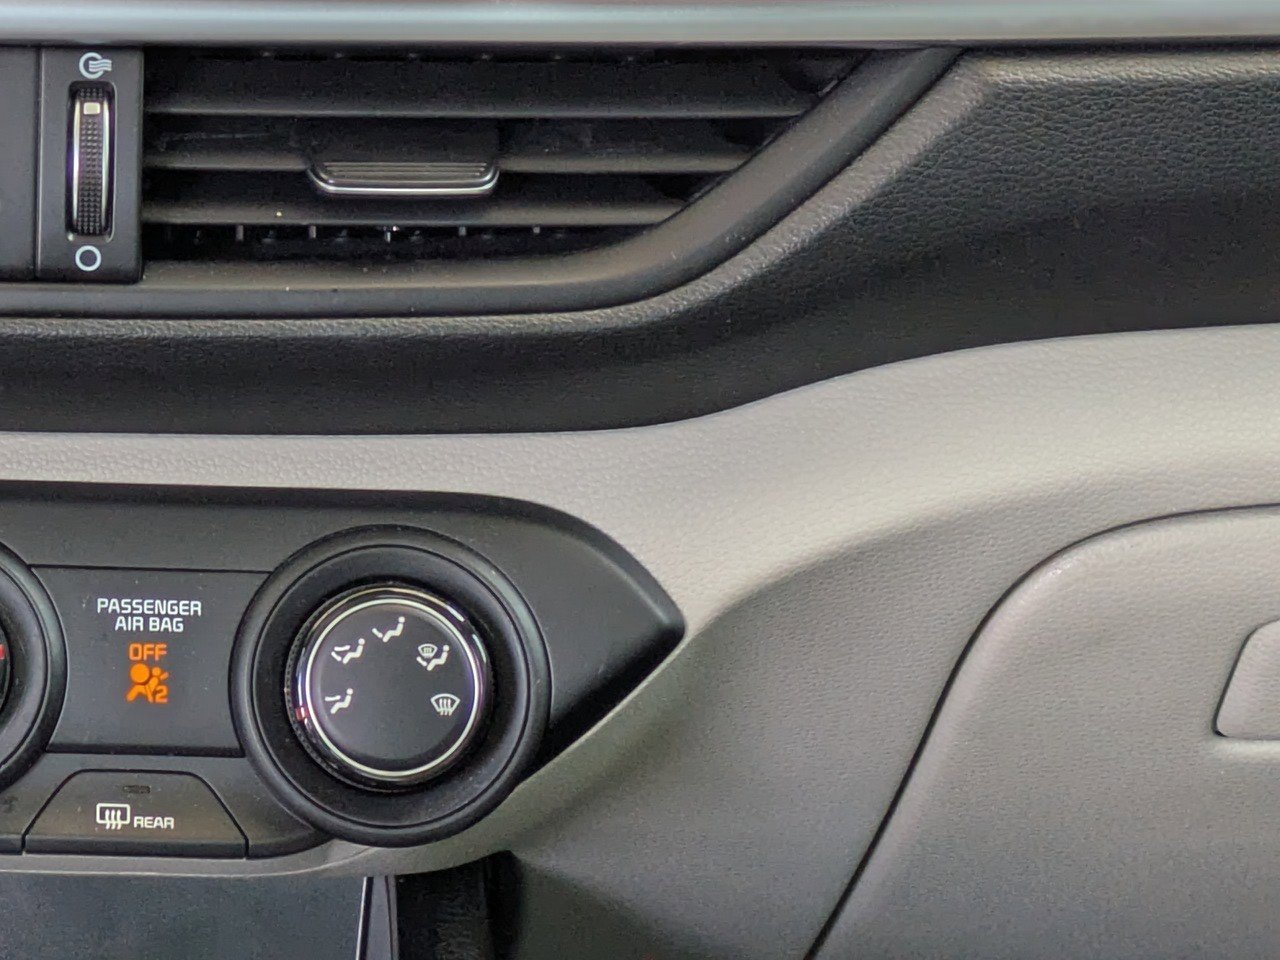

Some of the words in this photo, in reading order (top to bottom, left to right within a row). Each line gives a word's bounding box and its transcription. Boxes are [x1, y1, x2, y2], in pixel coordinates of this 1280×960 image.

[96, 597, 202, 617] PASSENGER
[114, 616, 145, 632] AIR
[148, 616, 184, 633] BAG
[128, 643, 168, 661] OFF
[133, 815, 175, 830] REAR
